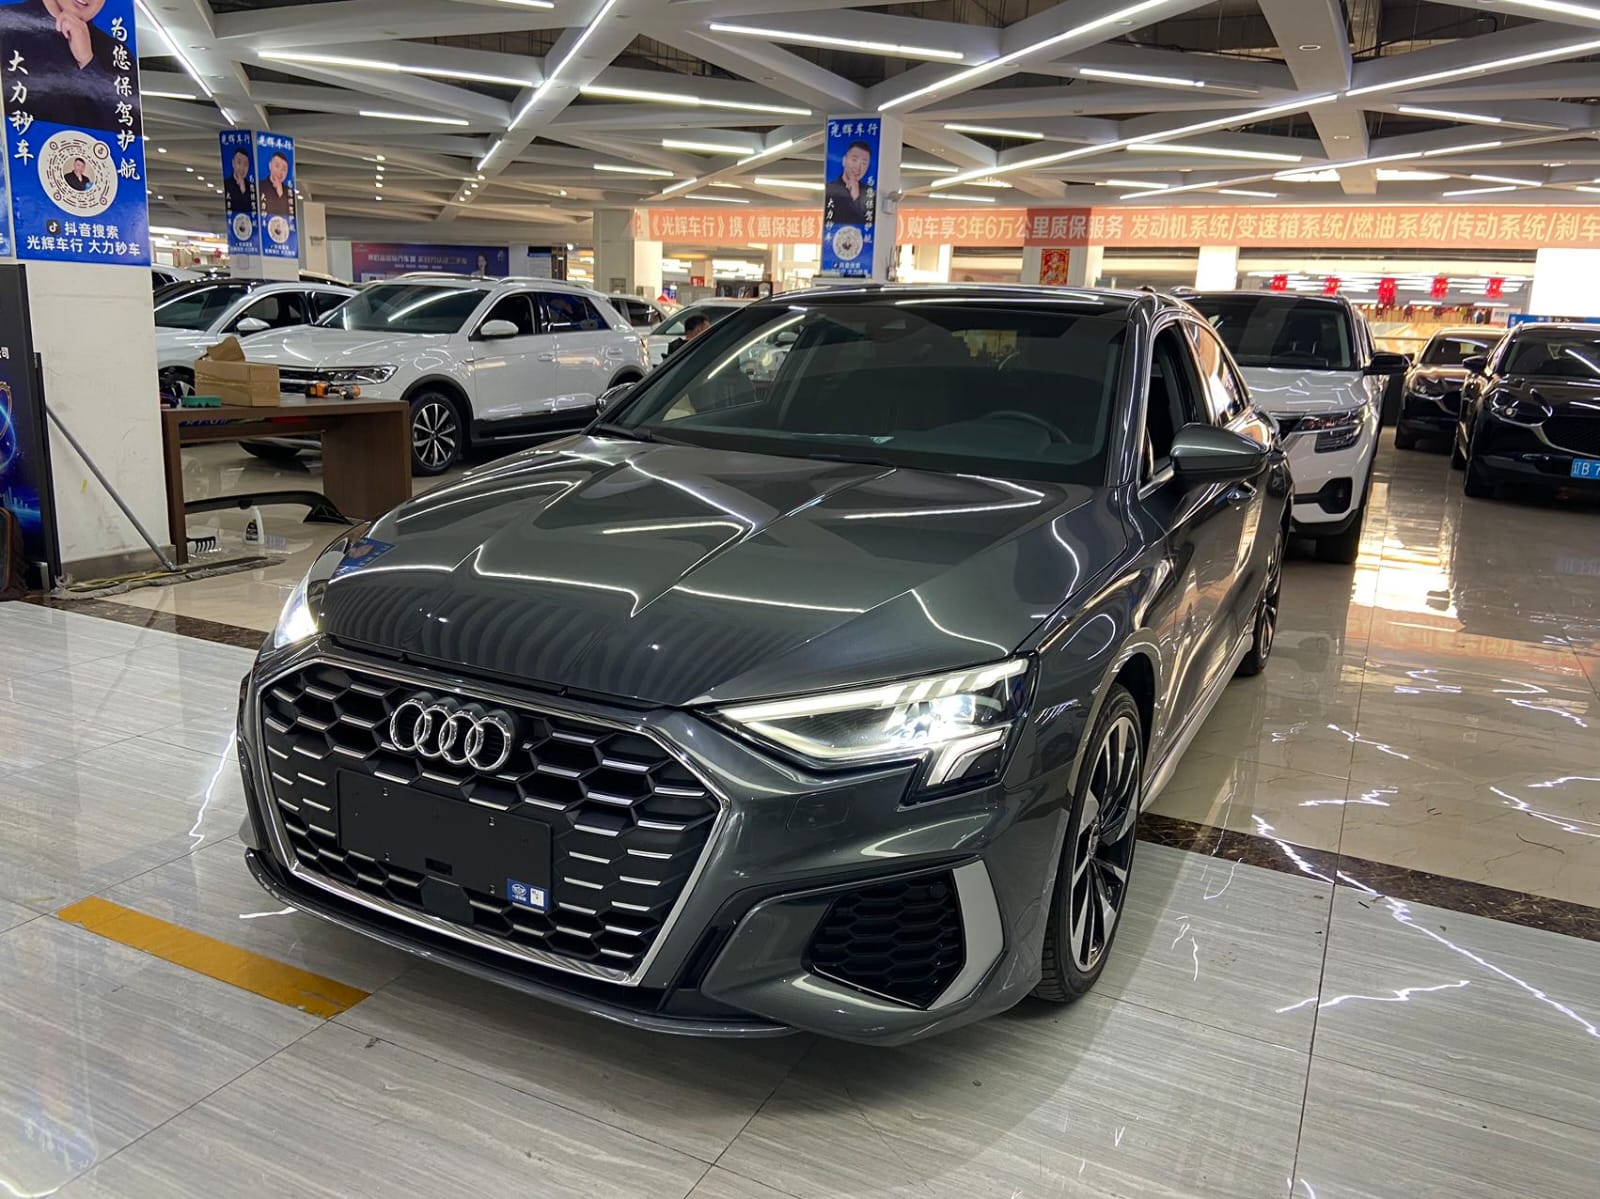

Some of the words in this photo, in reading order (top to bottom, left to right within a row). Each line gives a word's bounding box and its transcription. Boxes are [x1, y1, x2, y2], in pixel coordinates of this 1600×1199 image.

[8, 50, 34, 166] 大力秒车
[110, 17, 140, 180] 为您保驾护航
[27, 235, 83, 252] 光辉车行
[88, 240, 140, 256] 大力秒车
[64, 221, 119, 239] 抖音搜索
